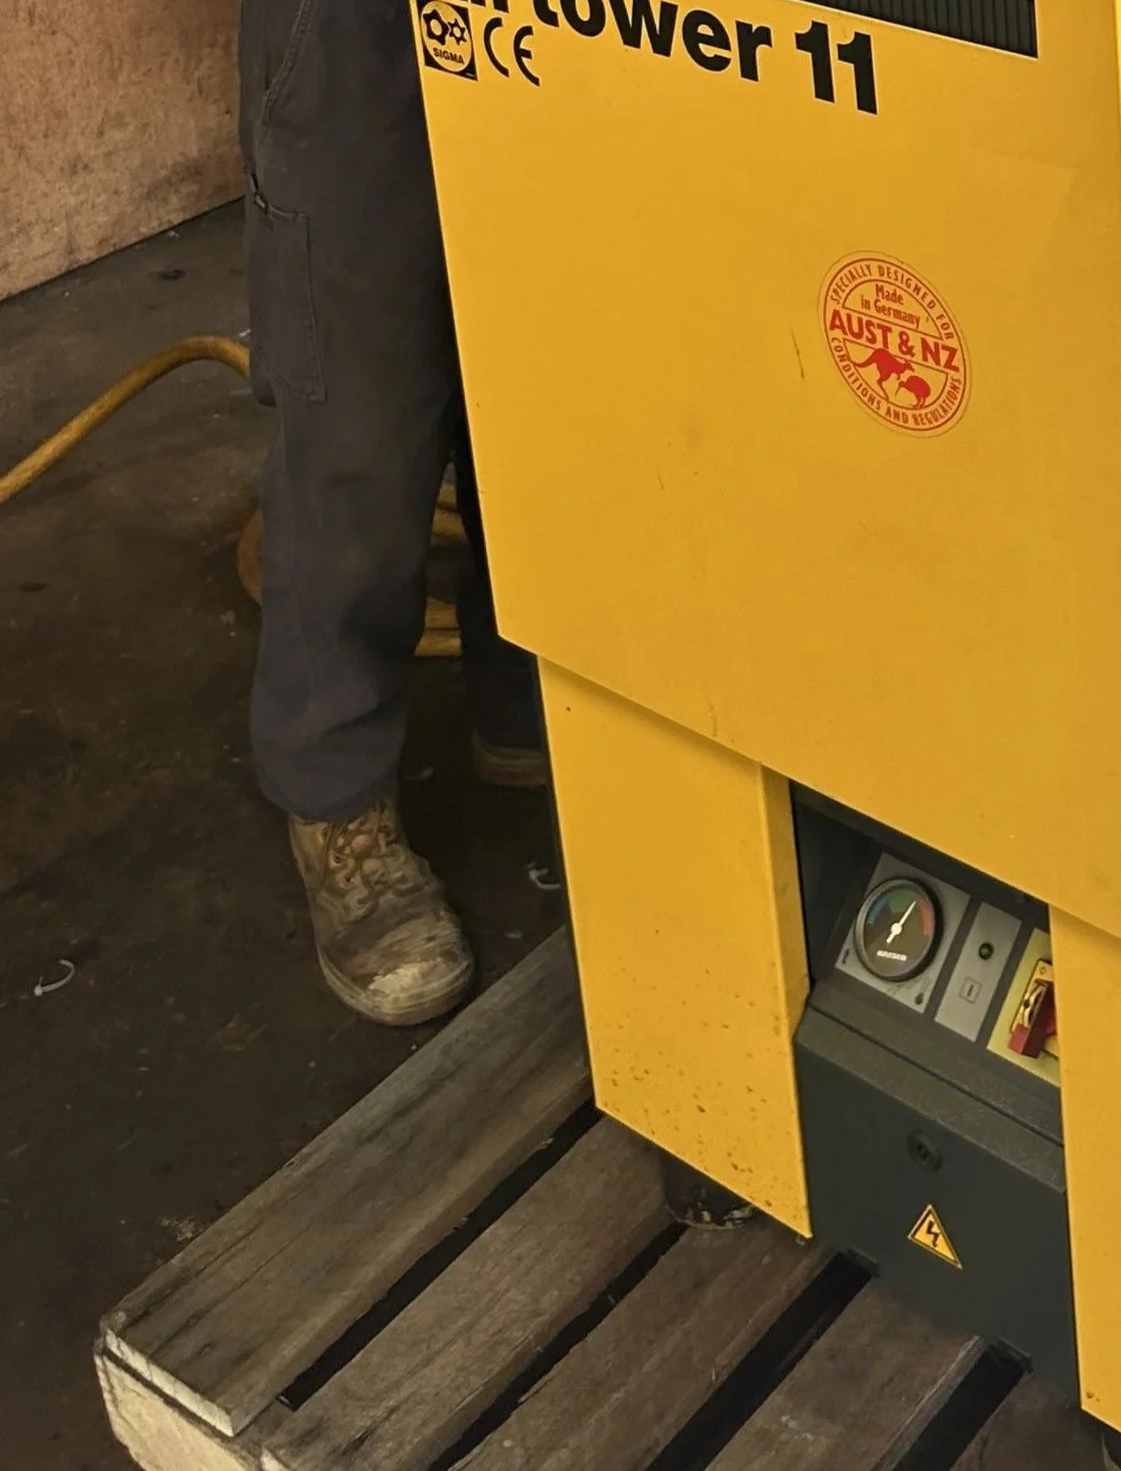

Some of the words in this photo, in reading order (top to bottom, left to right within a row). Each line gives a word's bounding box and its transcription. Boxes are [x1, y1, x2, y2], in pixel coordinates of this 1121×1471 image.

[432, 47, 465, 65] SIGMA
[795, 21, 878, 116] 11
[830, 264, 873, 305] SPECIALLY
[877, 265, 936, 310] DESIGNED
[936, 314, 955, 340] FOR
[860, 295, 871, 310] in
[874, 298, 921, 331] Germany
[875, 283, 904, 306] Made
[829, 309, 893, 350] AUST
[898, 331, 916, 358] &
[920, 337, 960, 373] NZ
[831, 337, 881, 411] CONDITIONS
[885, 405, 909, 425] AND
[912, 376, 962, 427] REGULATIONS
